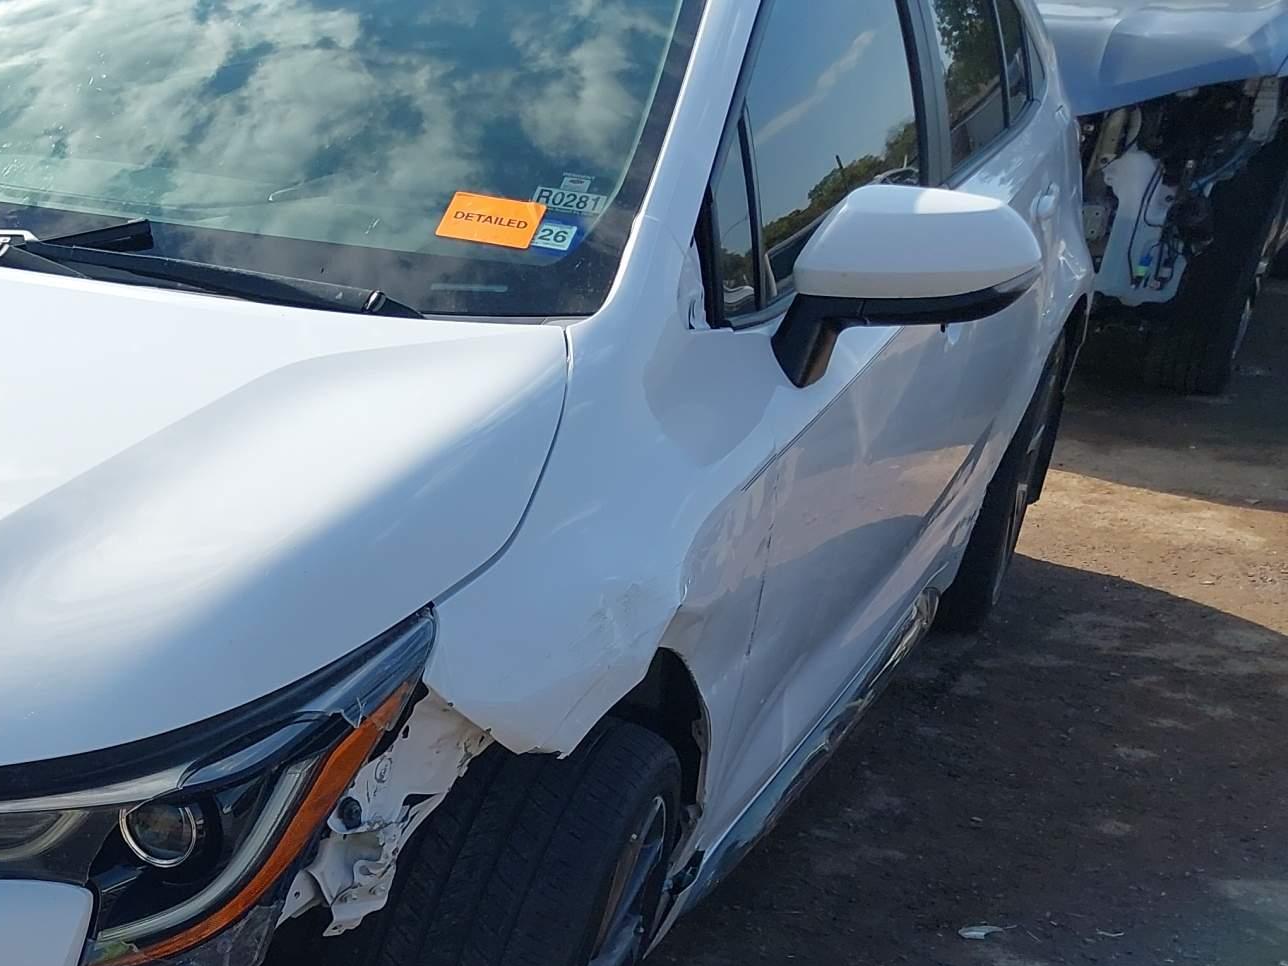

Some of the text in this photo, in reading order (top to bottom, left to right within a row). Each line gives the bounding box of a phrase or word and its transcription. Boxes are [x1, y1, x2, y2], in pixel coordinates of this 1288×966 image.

[536, 188, 601, 211] R0281
[453, 210, 528, 230] DETAILED
[538, 228, 569, 243] 26
